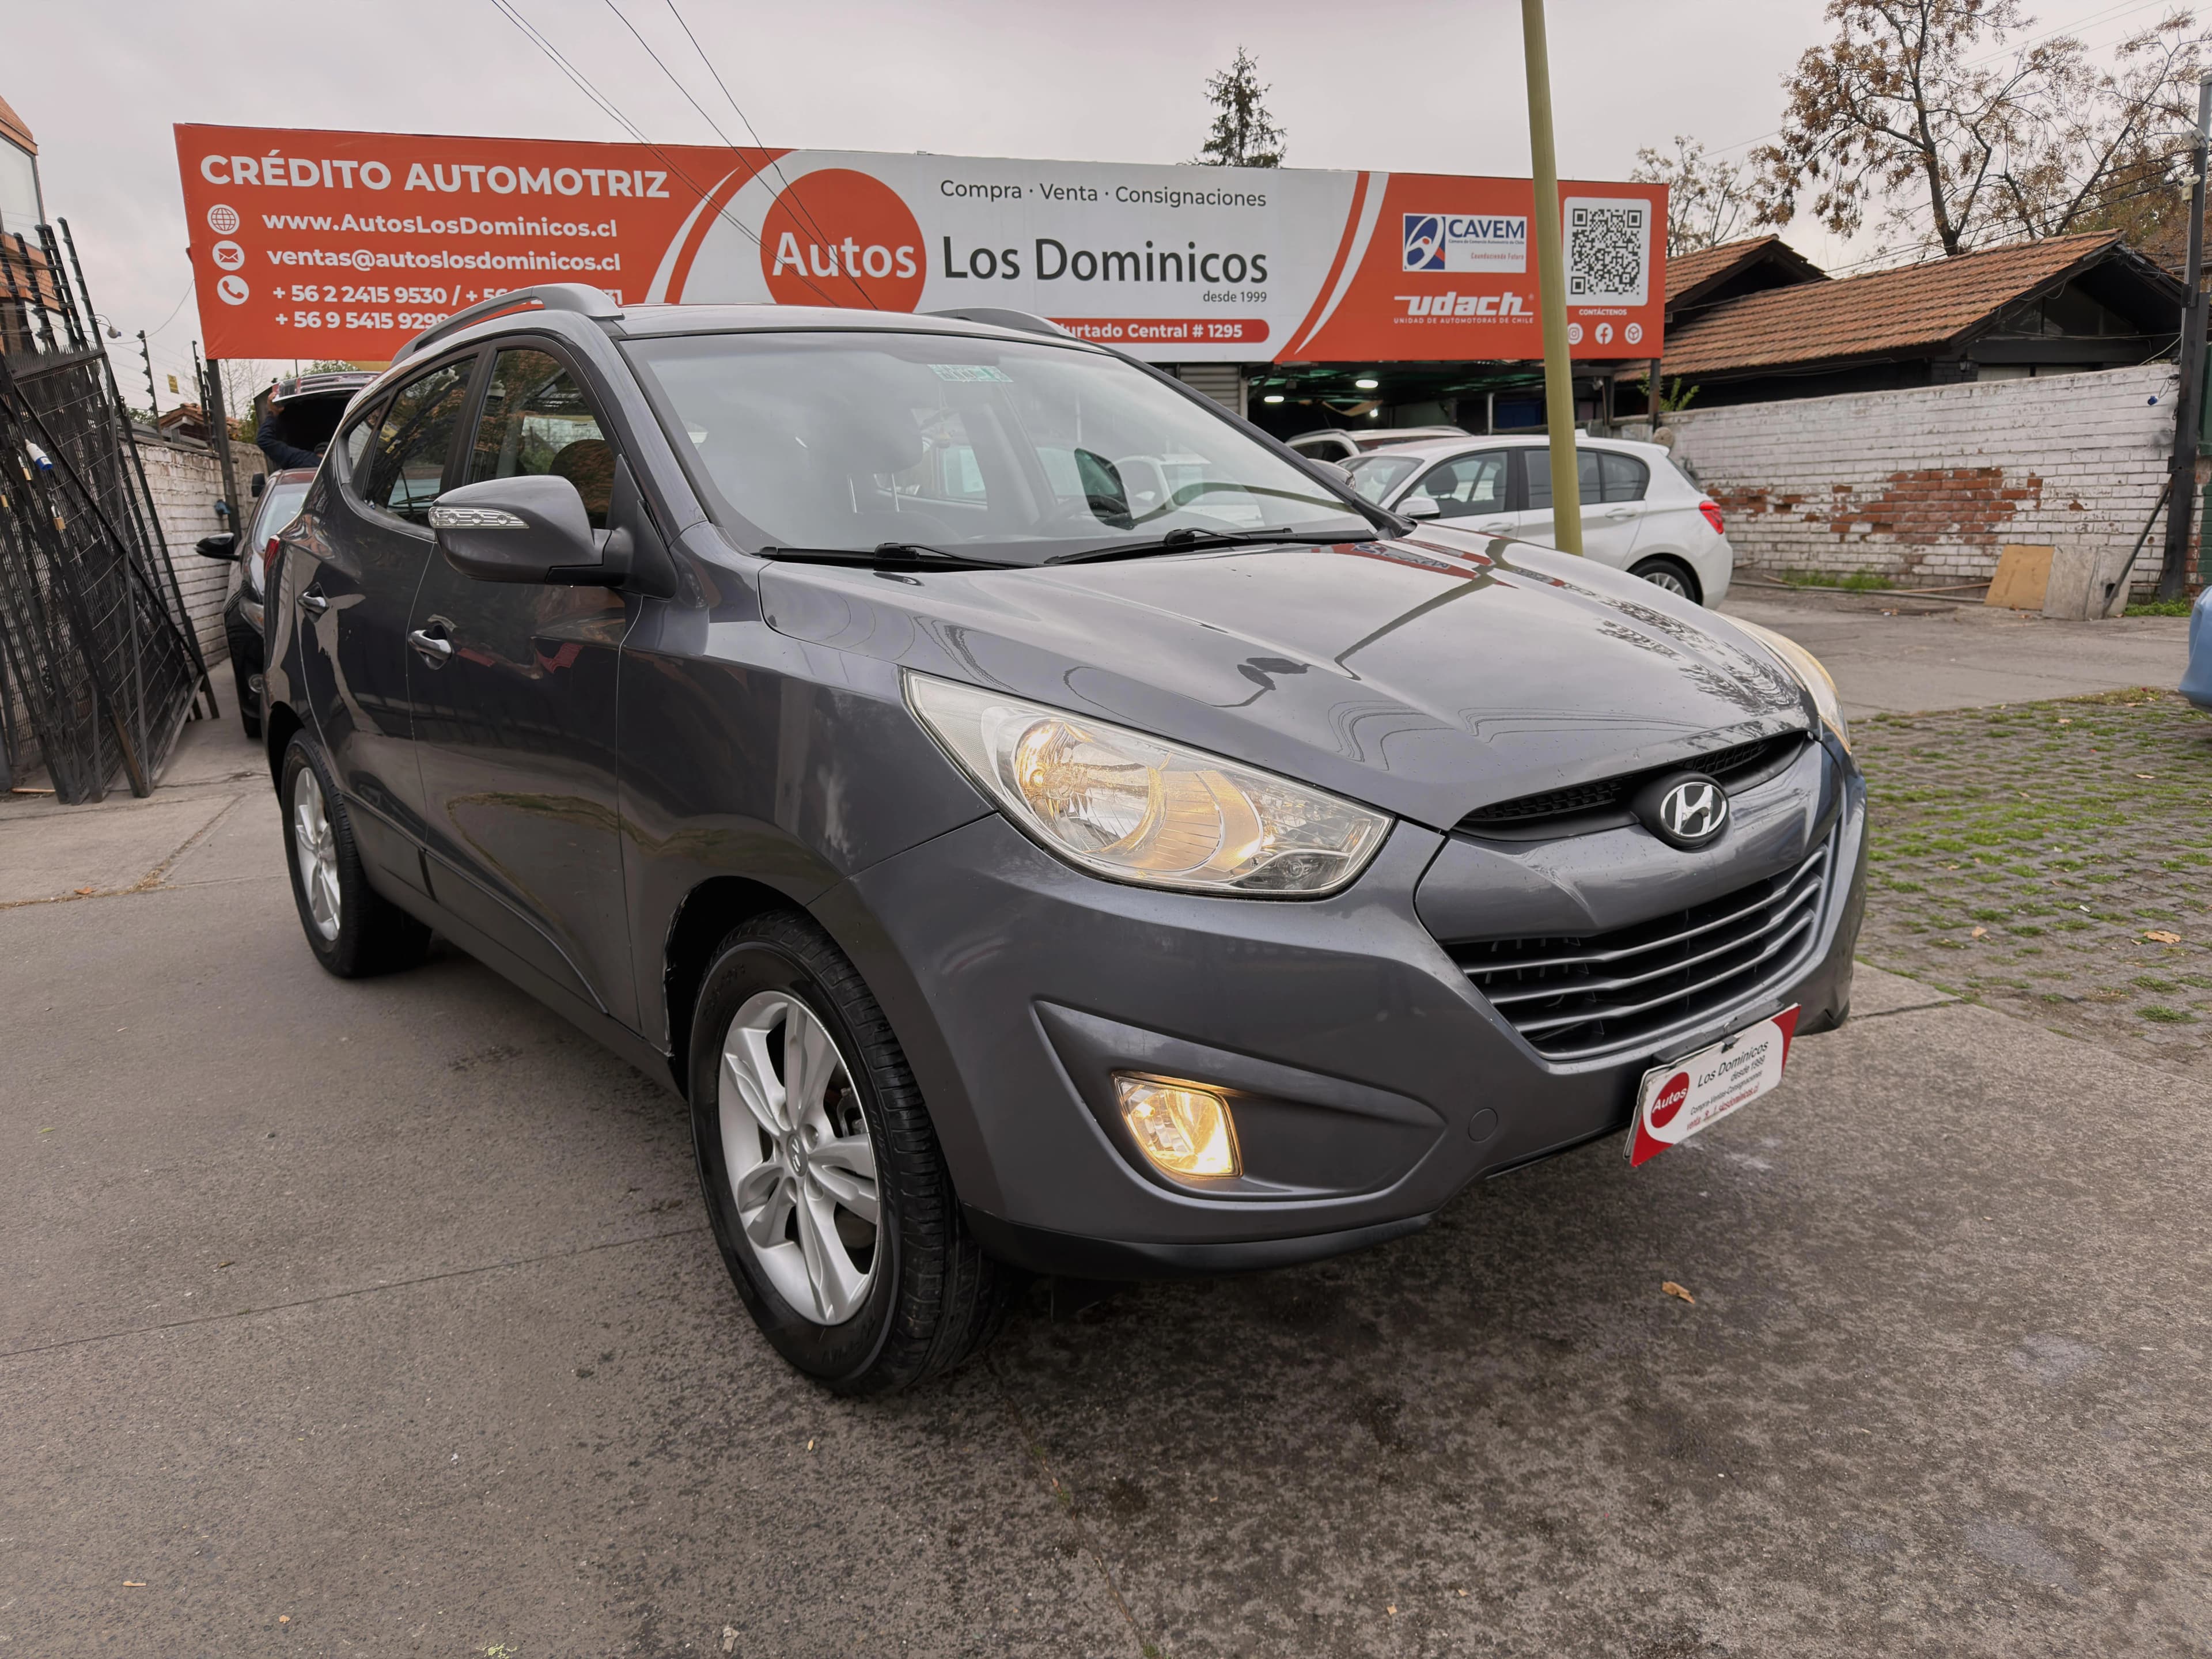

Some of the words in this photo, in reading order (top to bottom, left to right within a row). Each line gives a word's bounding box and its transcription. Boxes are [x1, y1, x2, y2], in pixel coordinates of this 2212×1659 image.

[200, 149, 392, 190] CRÉDITO
[404, 163, 670, 198] AUTOMOTRIZ
[940, 180, 1022, 202] Compra
[1039, 183, 1097, 202] Venta
[1115, 186, 1266, 208] Consignaciones
[262, 214, 617, 237] www.AutosLosDominicos.cl
[1449, 219, 1524, 238] CAVEM
[266, 249, 620, 271] ventas@autoslosdominicos.cl
[772, 232, 916, 278] Autos
[943, 236, 1020, 280] Los
[1035, 238, 1268, 283] Dominicos
[291, 285, 319, 302] 56
[322, 285, 338, 302] 2
[340, 286, 391, 304] 2415
[393, 286, 448, 304] 9530
[1203, 290, 1237, 302] desde
[1241, 291, 1267, 302] 1999
[1394, 291, 1534, 316] udach
[294, 311, 322, 328] 56
[325, 311, 340, 328] 9
[345, 312, 394, 329] 5415
[1579, 308, 1627, 316] CONTÁCTENOS
[1060, 323, 1123, 338] urtado
[1127, 323, 1187, 338] Central
[1192, 324, 1204, 338] #
[1207, 324, 1243, 338] 1295
[1698, 1070, 1716, 1088] Los
[1718, 1041, 1769, 1076] Dominicos
[1652, 1087, 1688, 1113] Autos
